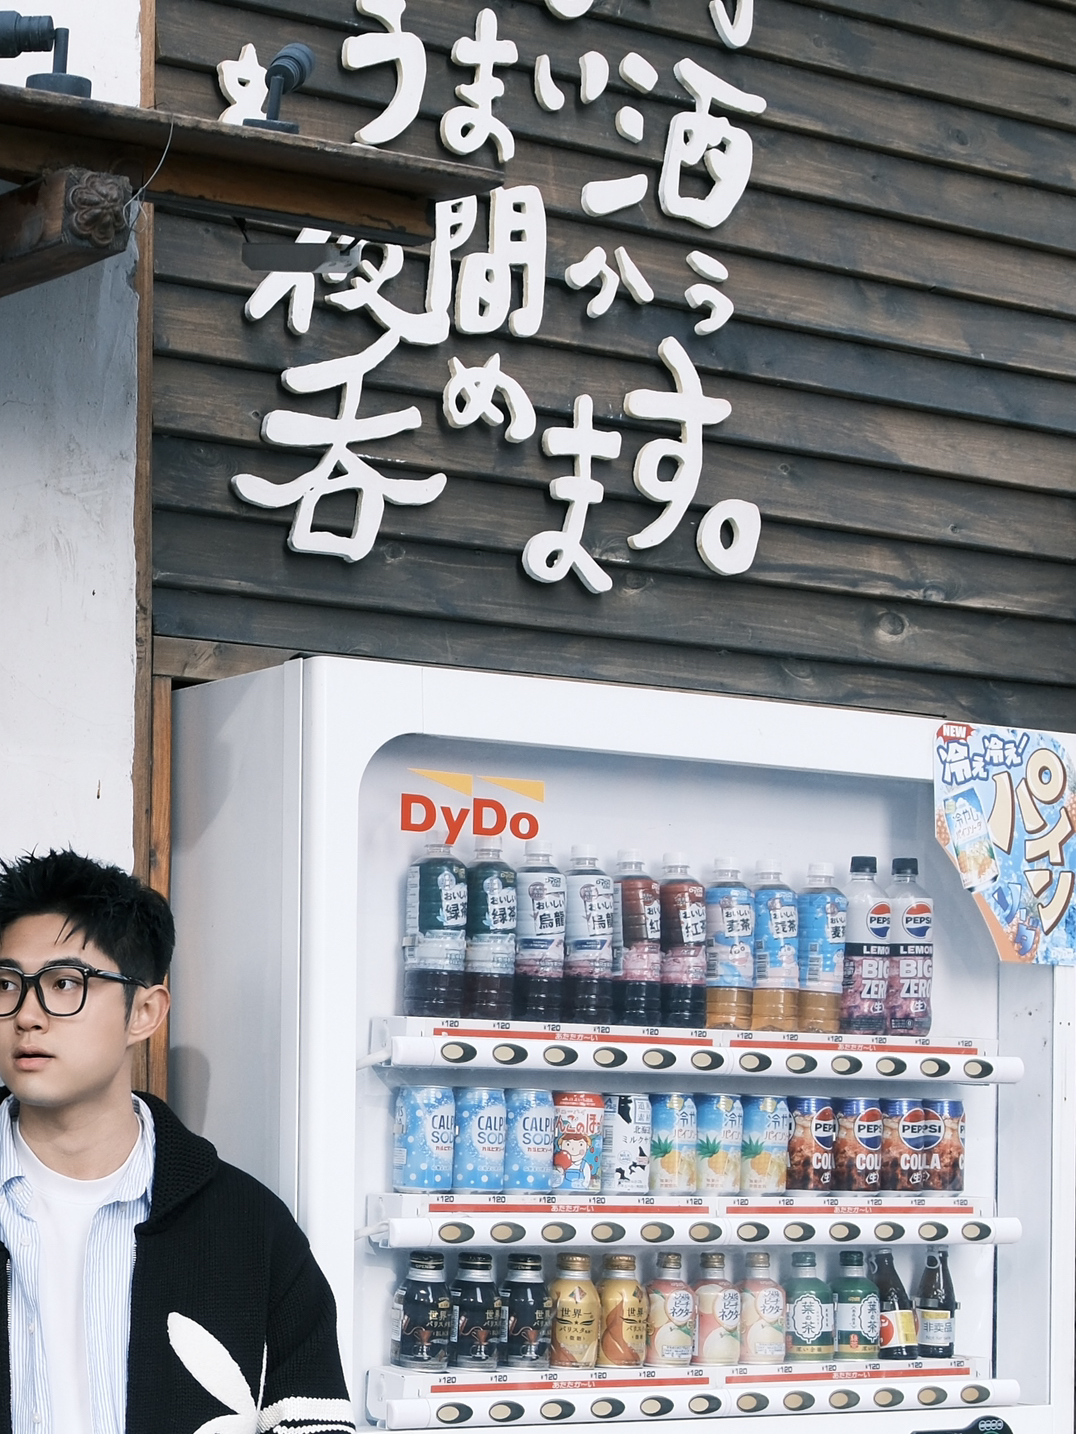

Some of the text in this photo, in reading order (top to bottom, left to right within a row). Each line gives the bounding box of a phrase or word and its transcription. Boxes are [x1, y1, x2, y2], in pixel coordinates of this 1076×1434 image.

[942, 725, 967, 738] NEW
[400, 793, 539, 845] DyDo
[900, 959, 933, 978] BIG
[801, 1301, 816, 1334] 葉の茶
[923, 1321, 952, 1333] 非卖品
